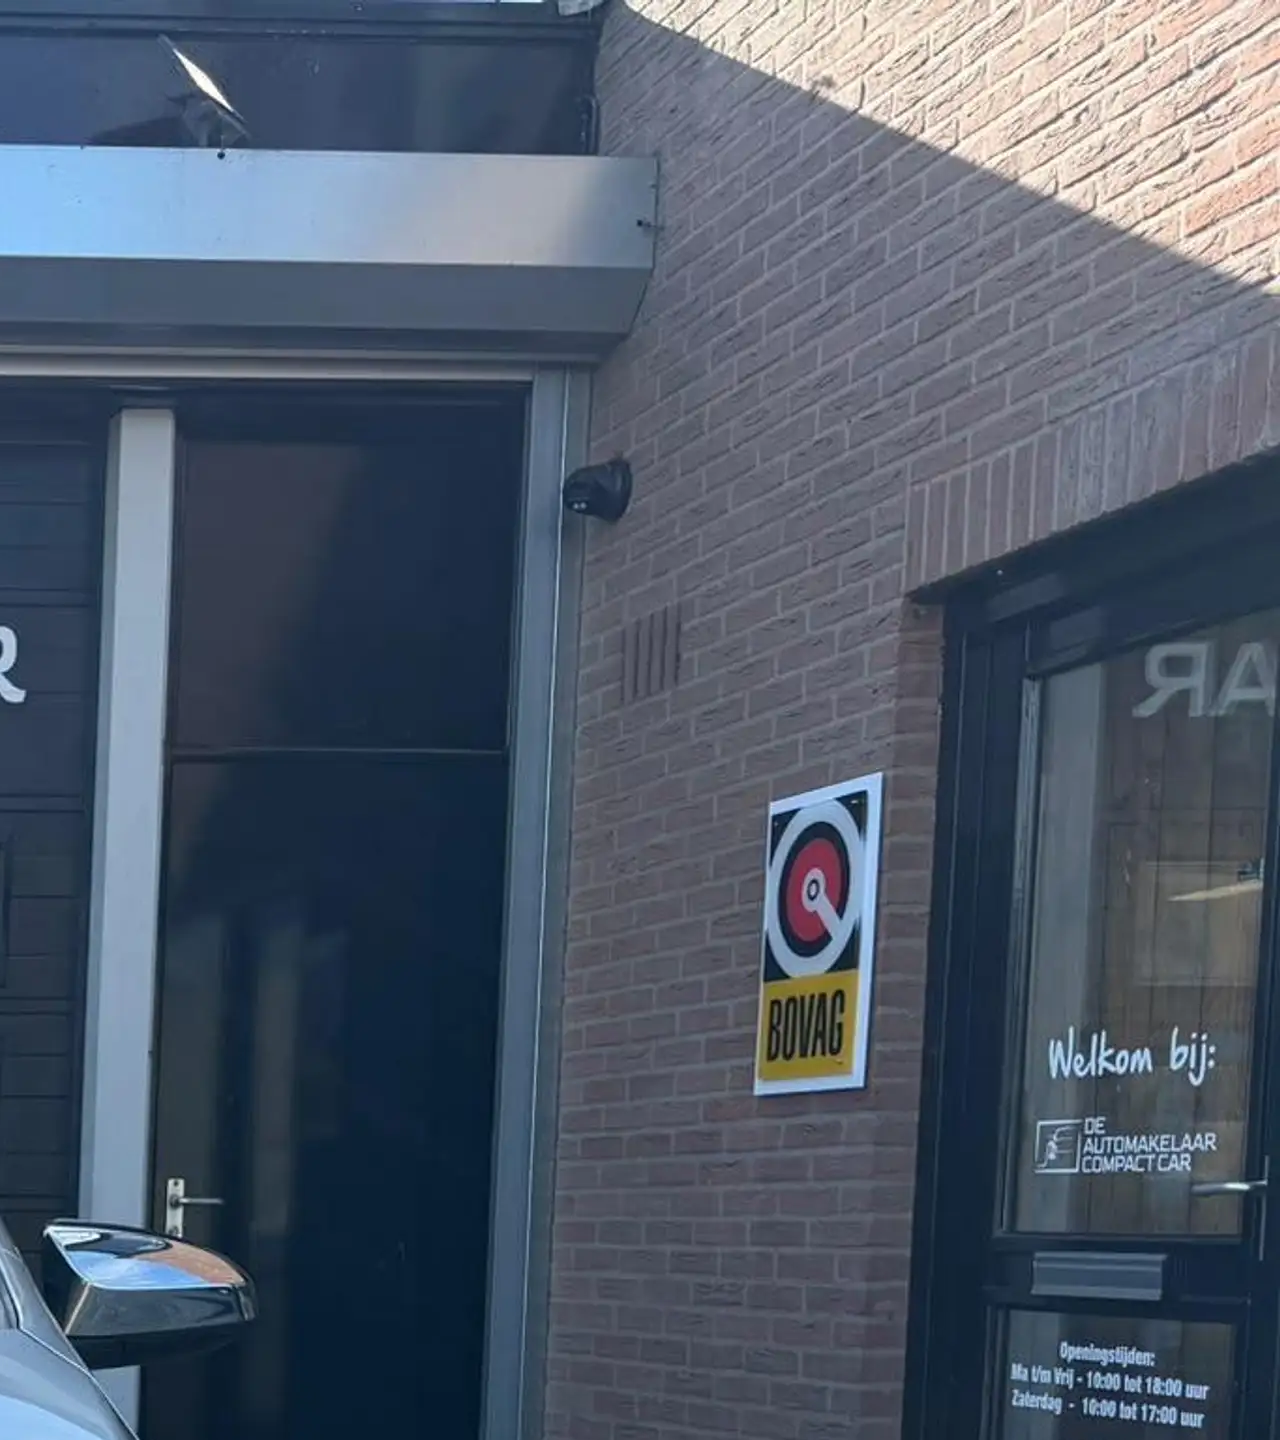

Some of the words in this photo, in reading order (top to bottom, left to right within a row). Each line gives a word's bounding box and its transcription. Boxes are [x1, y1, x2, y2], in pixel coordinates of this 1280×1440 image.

[766, 989, 845, 1063] BOVAG
[1049, 1025, 1153, 1079] Welkom
[1169, 1026, 1216, 1086] bij:
[1084, 1117, 1106, 1135] DE
[1083, 1132, 1217, 1154] AUTOMAKELAAR
[1081, 1155, 1155, 1173] COMPACT
[1158, 1153, 1192, 1172] CAR
[1060, 1341, 1156, 1368] Openingstijden:
[1011, 1363, 1027, 1382] Ma
[1031, 1365, 1051, 1384] t/m
[1054, 1368, 1075, 1390] Vrij
[1087, 1371, 1120, 1391] 10:00
[1124, 1375, 1142, 1393] tot
[1146, 1377, 1181, 1397] 18:00
[1186, 1384, 1210, 1400] uur
[1011, 1389, 1062, 1415] Zaterdag
[1082, 1396, 1116, 1418] 10:00
[1119, 1401, 1137, 1420] tot
[1141, 1404, 1177, 1425] 17:00
[1180, 1412, 1205, 1428] uur
